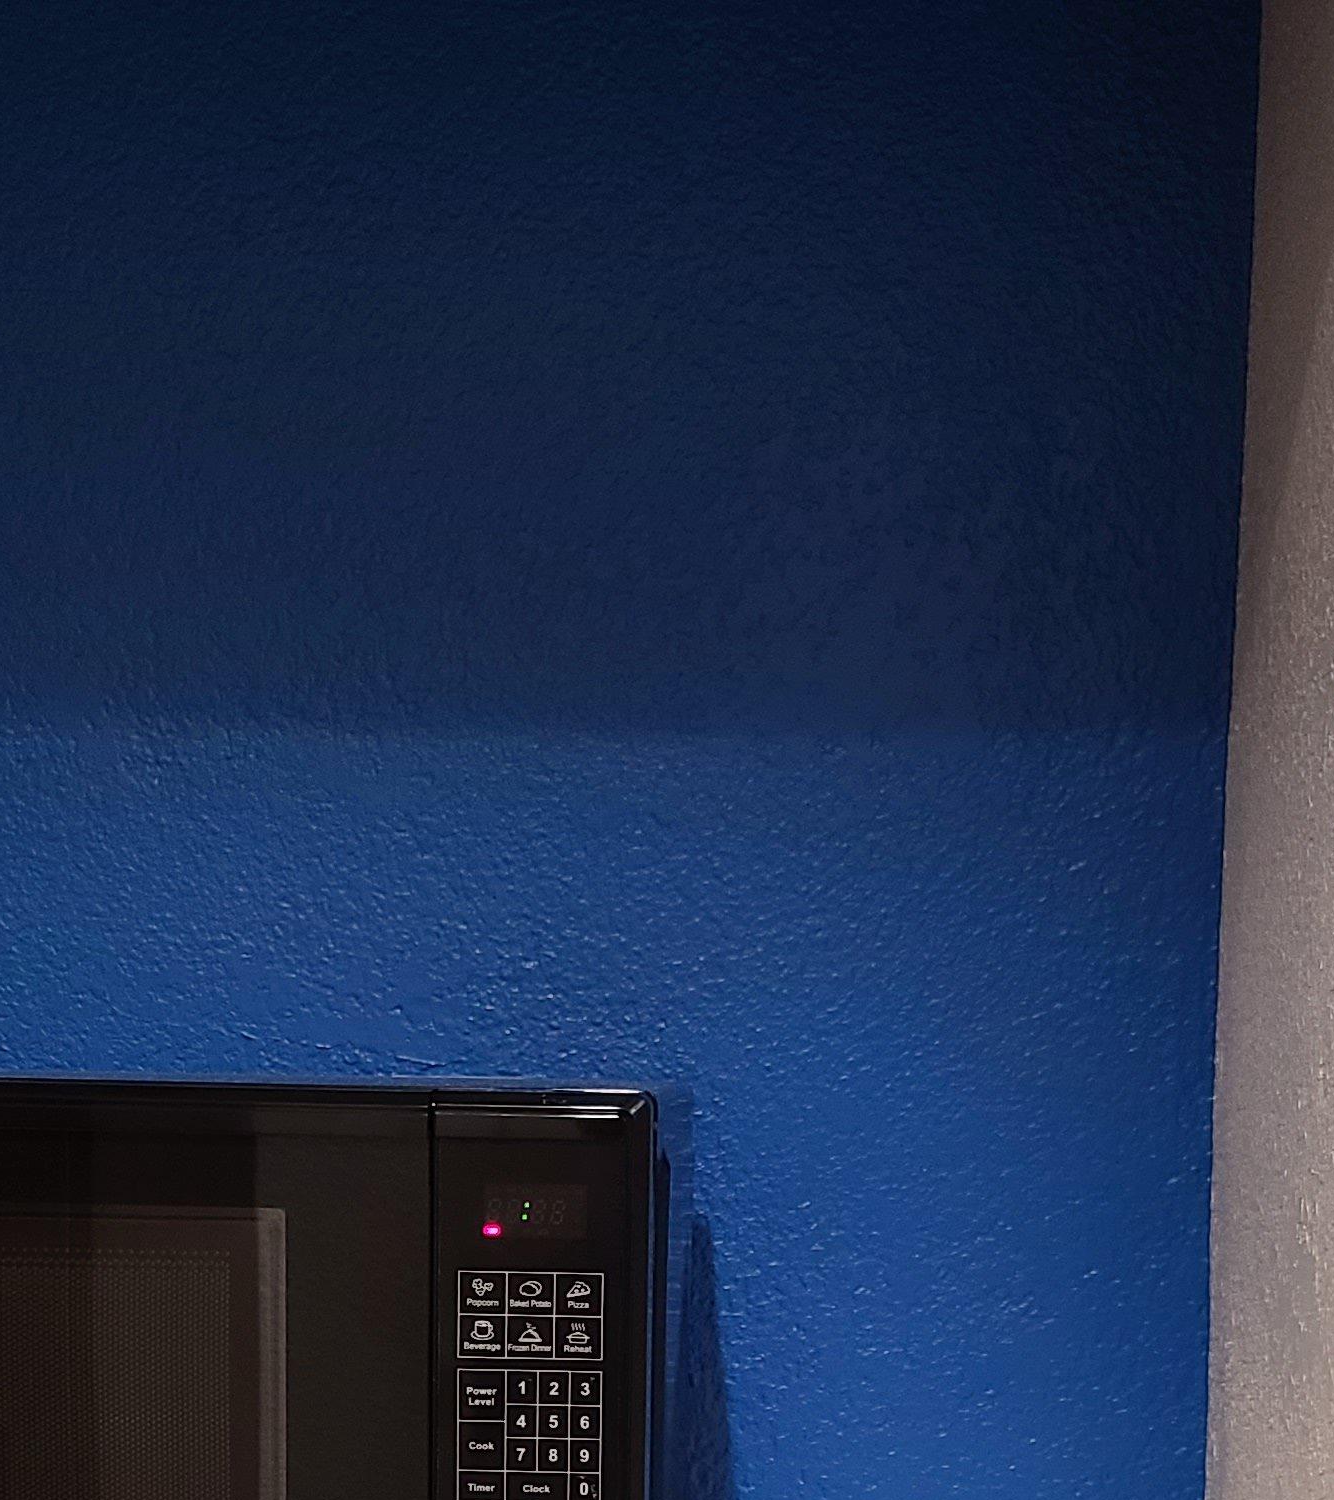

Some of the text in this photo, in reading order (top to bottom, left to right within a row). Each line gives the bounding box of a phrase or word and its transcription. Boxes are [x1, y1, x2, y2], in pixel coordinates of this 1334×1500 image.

[467, 1298, 499, 1307] Popcorn
[568, 1301, 589, 1309] Pizza
[464, 1342, 501, 1352] Beverage
[564, 1345, 592, 1353] Reheat
[466, 1387, 497, 1396] Power
[518, 1381, 526, 1394] 1
[549, 1382, 559, 1395] 2
[580, 1383, 591, 1396] 3
[468, 1397, 495, 1406] Level
[516, 1415, 527, 1428] 4
[549, 1415, 559, 1428] 5
[580, 1416, 590, 1429] 6
[468, 1441, 494, 1450] Cook
[516, 1448, 526, 1461] 7
[549, 1449, 558, 1462] 8
[580, 1449, 590, 1462] 9
[467, 1483, 495, 1492] Timer
[522, 1485, 551, 1493] Clock
[580, 1482, 589, 1495] 0
